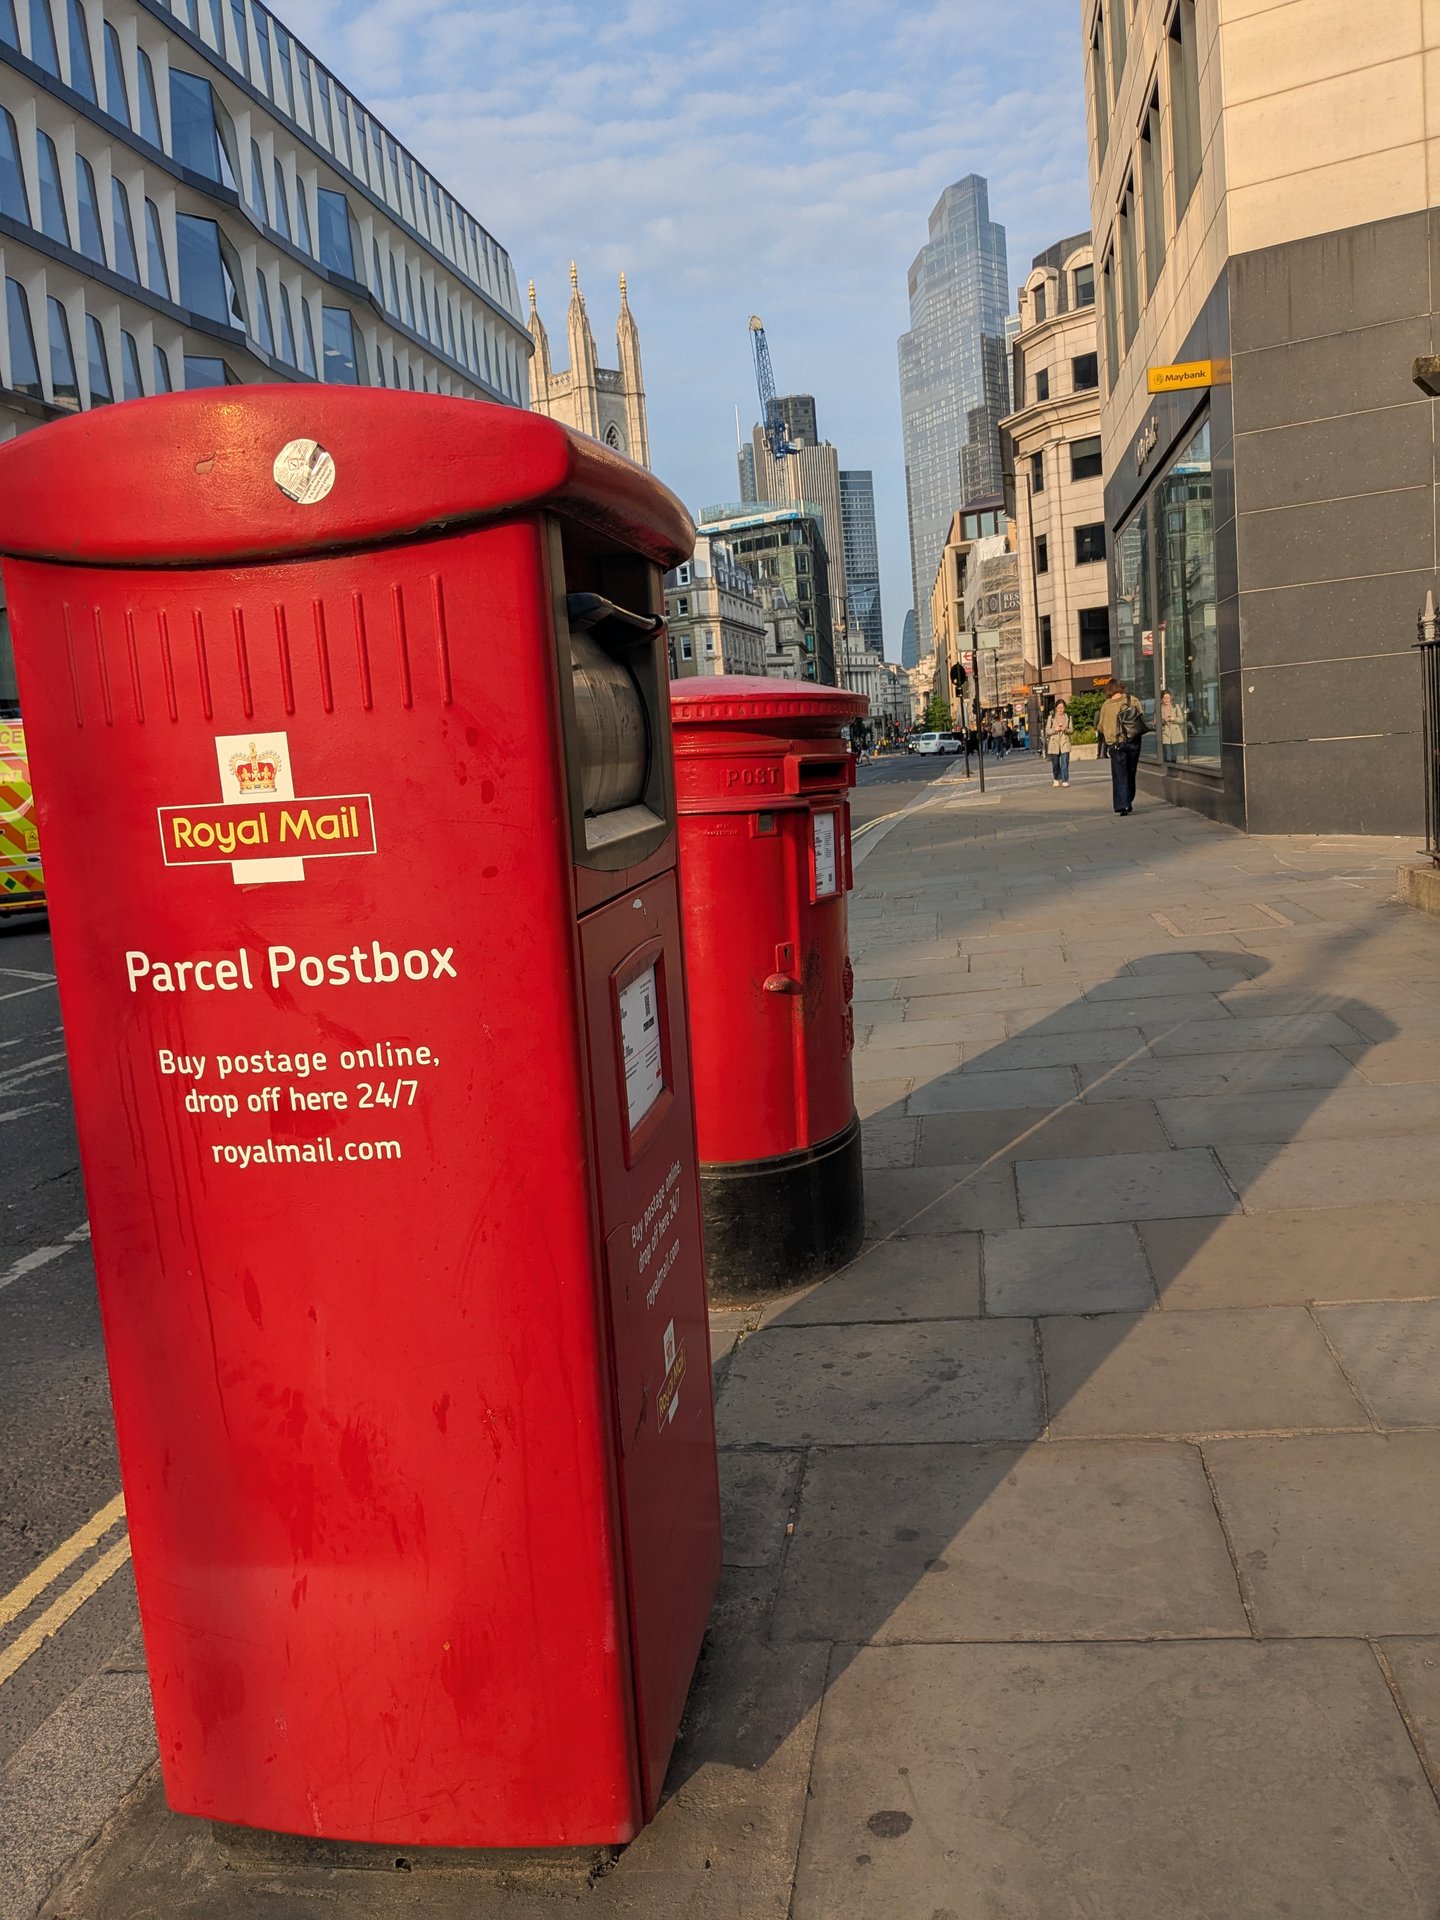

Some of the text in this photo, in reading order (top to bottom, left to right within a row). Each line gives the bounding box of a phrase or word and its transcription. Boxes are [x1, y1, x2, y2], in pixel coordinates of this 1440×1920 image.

[1165, 370, 1206, 382] Maybank
[726, 767, 779, 788] POST
[173, 807, 359, 853] Royal Mail
[126, 941, 458, 993] Parcel Postbox
[159, 1042, 440, 1080] Buy postage online,
[185, 1079, 418, 1118] drop off here 24/7
[212, 1138, 402, 1169] royalmail.com
[632, 1218, 643, 1249] Buy
[644, 1184, 665, 1233] postage
[639, 1243, 651, 1274] drop
[659, 1211, 670, 1239] here
[646, 1238, 680, 1310] royalmail.com
[659, 1372, 674, 1417] Royal
